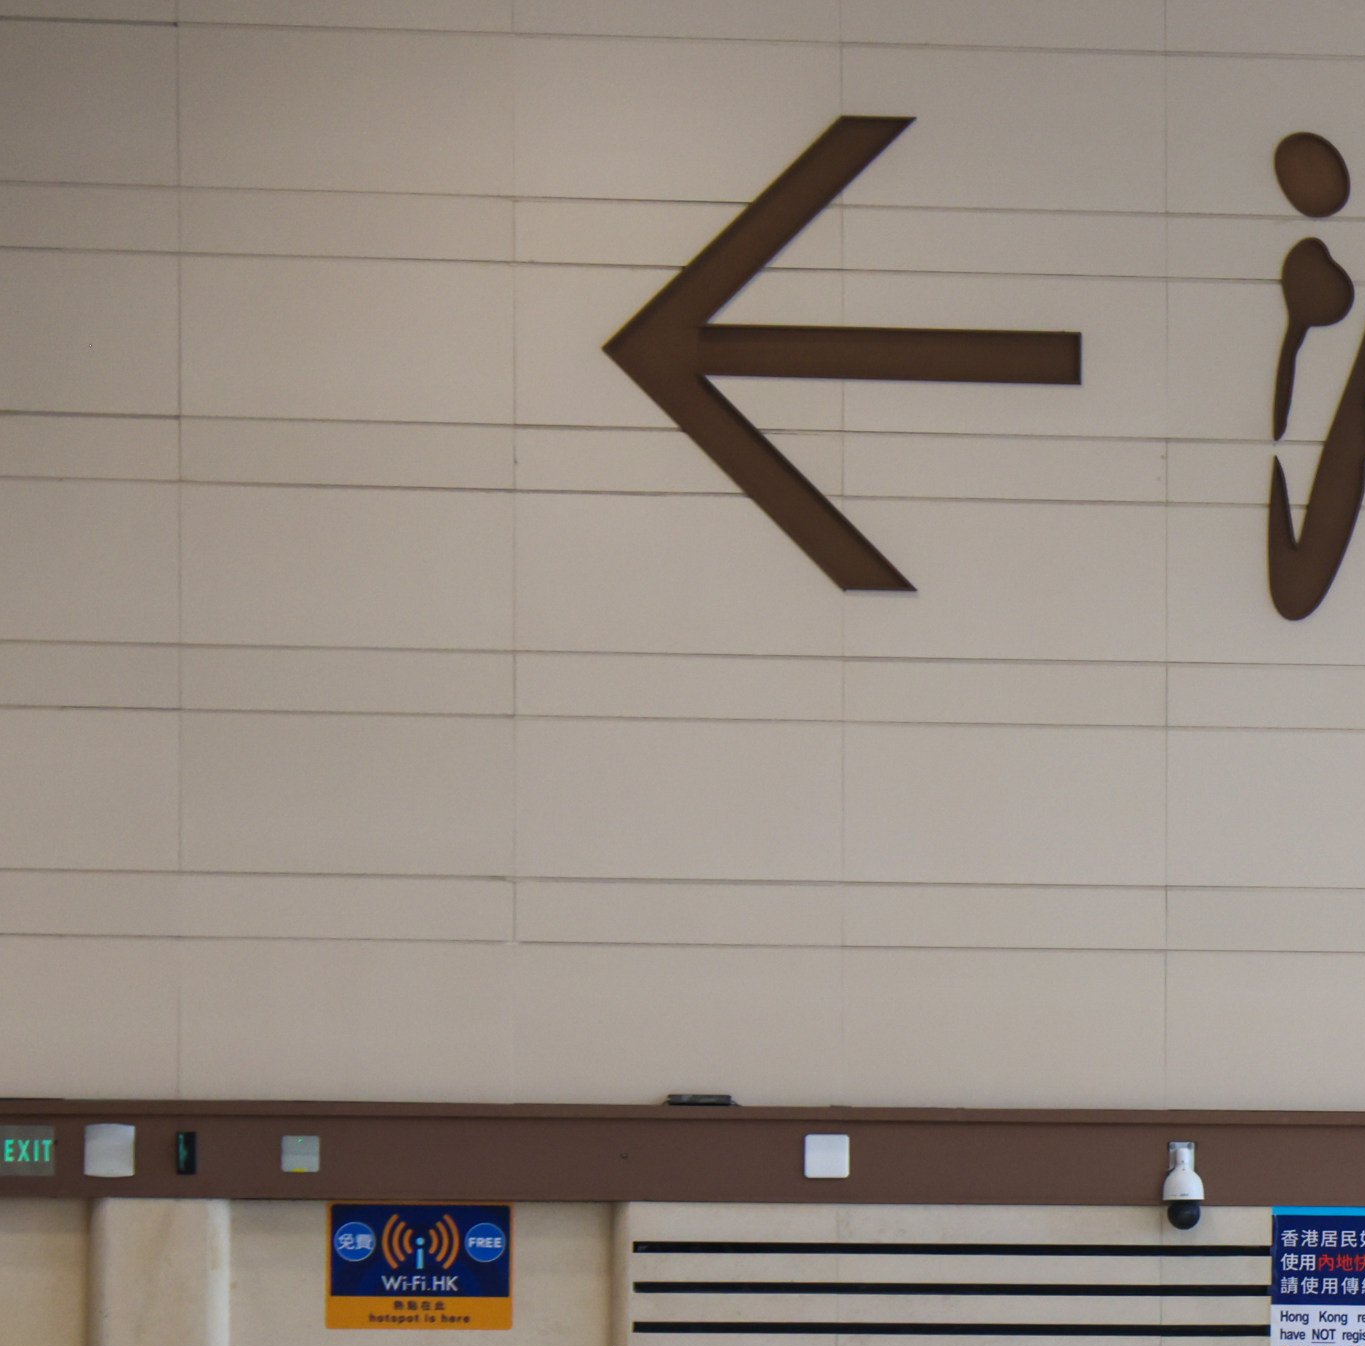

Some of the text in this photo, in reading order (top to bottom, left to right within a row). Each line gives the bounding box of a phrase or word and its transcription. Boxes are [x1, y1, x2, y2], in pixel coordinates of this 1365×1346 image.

[4, 1139, 52, 1162] EXIT
[337, 1233, 374, 1250] 免費
[468, 1237, 503, 1248] FREE
[381, 1275, 459, 1292] Wi-Fi.HK
[368, 1313, 471, 1325] hotspot is here
[1280, 1311, 1310, 1326] Hong
[1319, 1311, 1348, 1326] Kong
[1280, 1329, 1306, 1341] have
[1311, 1329, 1337, 1341] NOT
